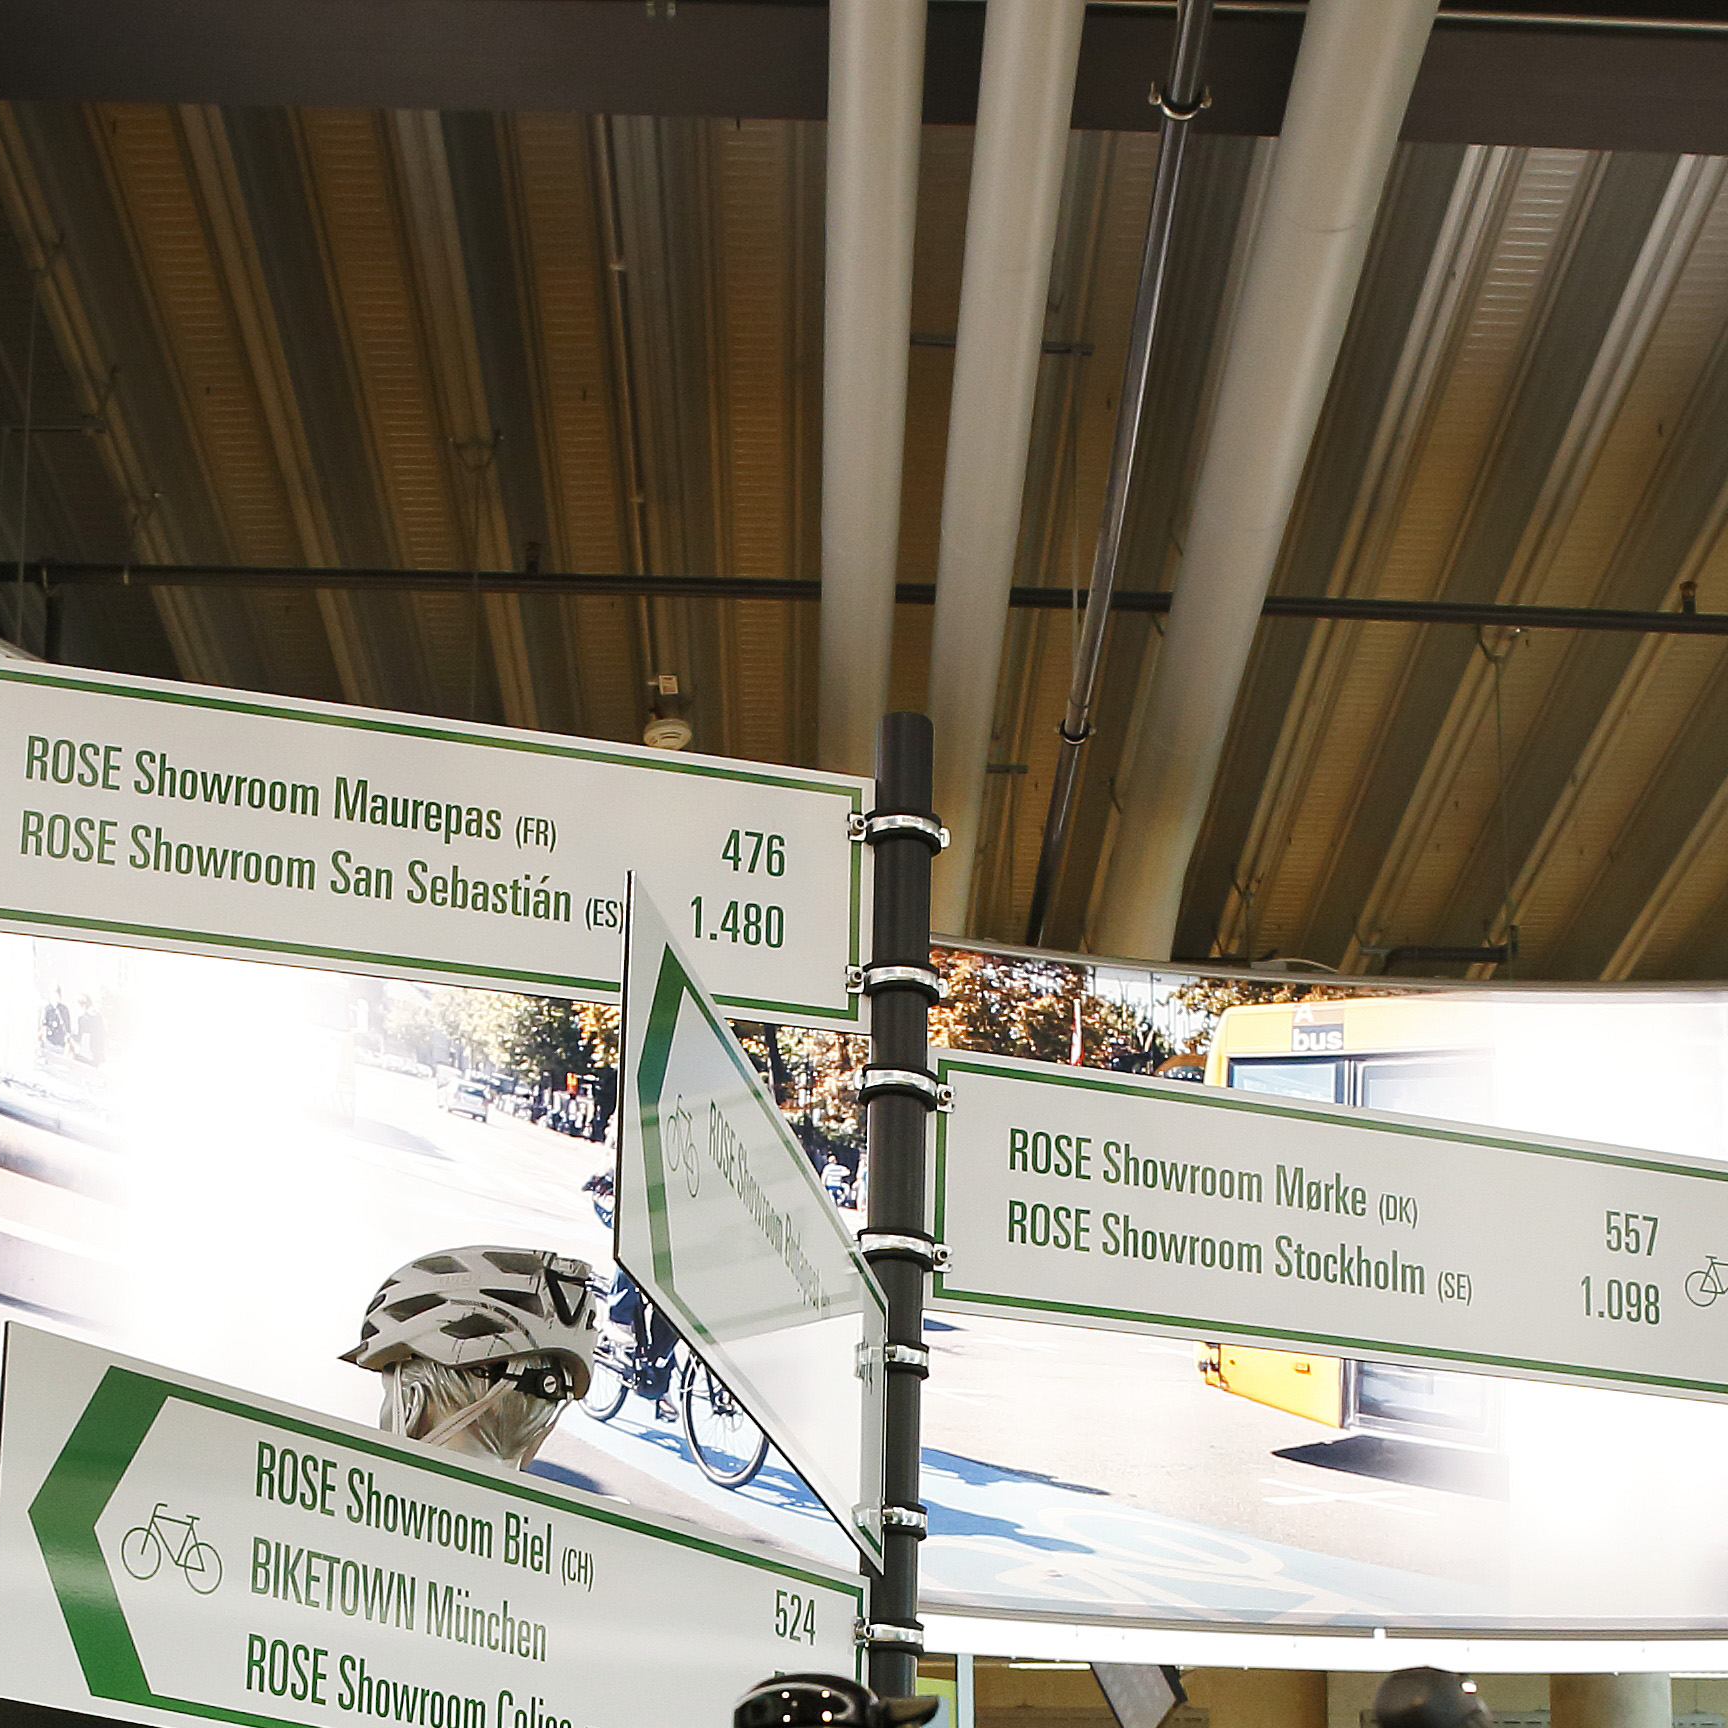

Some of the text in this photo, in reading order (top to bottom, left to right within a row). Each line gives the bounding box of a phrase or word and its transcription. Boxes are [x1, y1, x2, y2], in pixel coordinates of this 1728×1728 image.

[26, 736, 785, 876] ROSE Showroom Maurepas (FR) 476
[21, 810, 783, 948] ROSE Showroom San Sebastián (ES) 1.480
[1292, 1028, 1343, 1052] bus
[708, 1099, 736, 1187] ROSE
[737, 1140, 783, 1259] Showroom
[1010, 1128, 1658, 1256] ROSE Showroom Mørke (DK) 557
[1009, 1200, 1659, 1325] ROSE Showroom Stockholm (SE) 1.098
[252, 1441, 593, 1630] ROSE Showroom Biel (CH) BIKETOWN
[246, 1633, 328, 1705] ROSE
[427, 1581, 815, 1662] München 524
